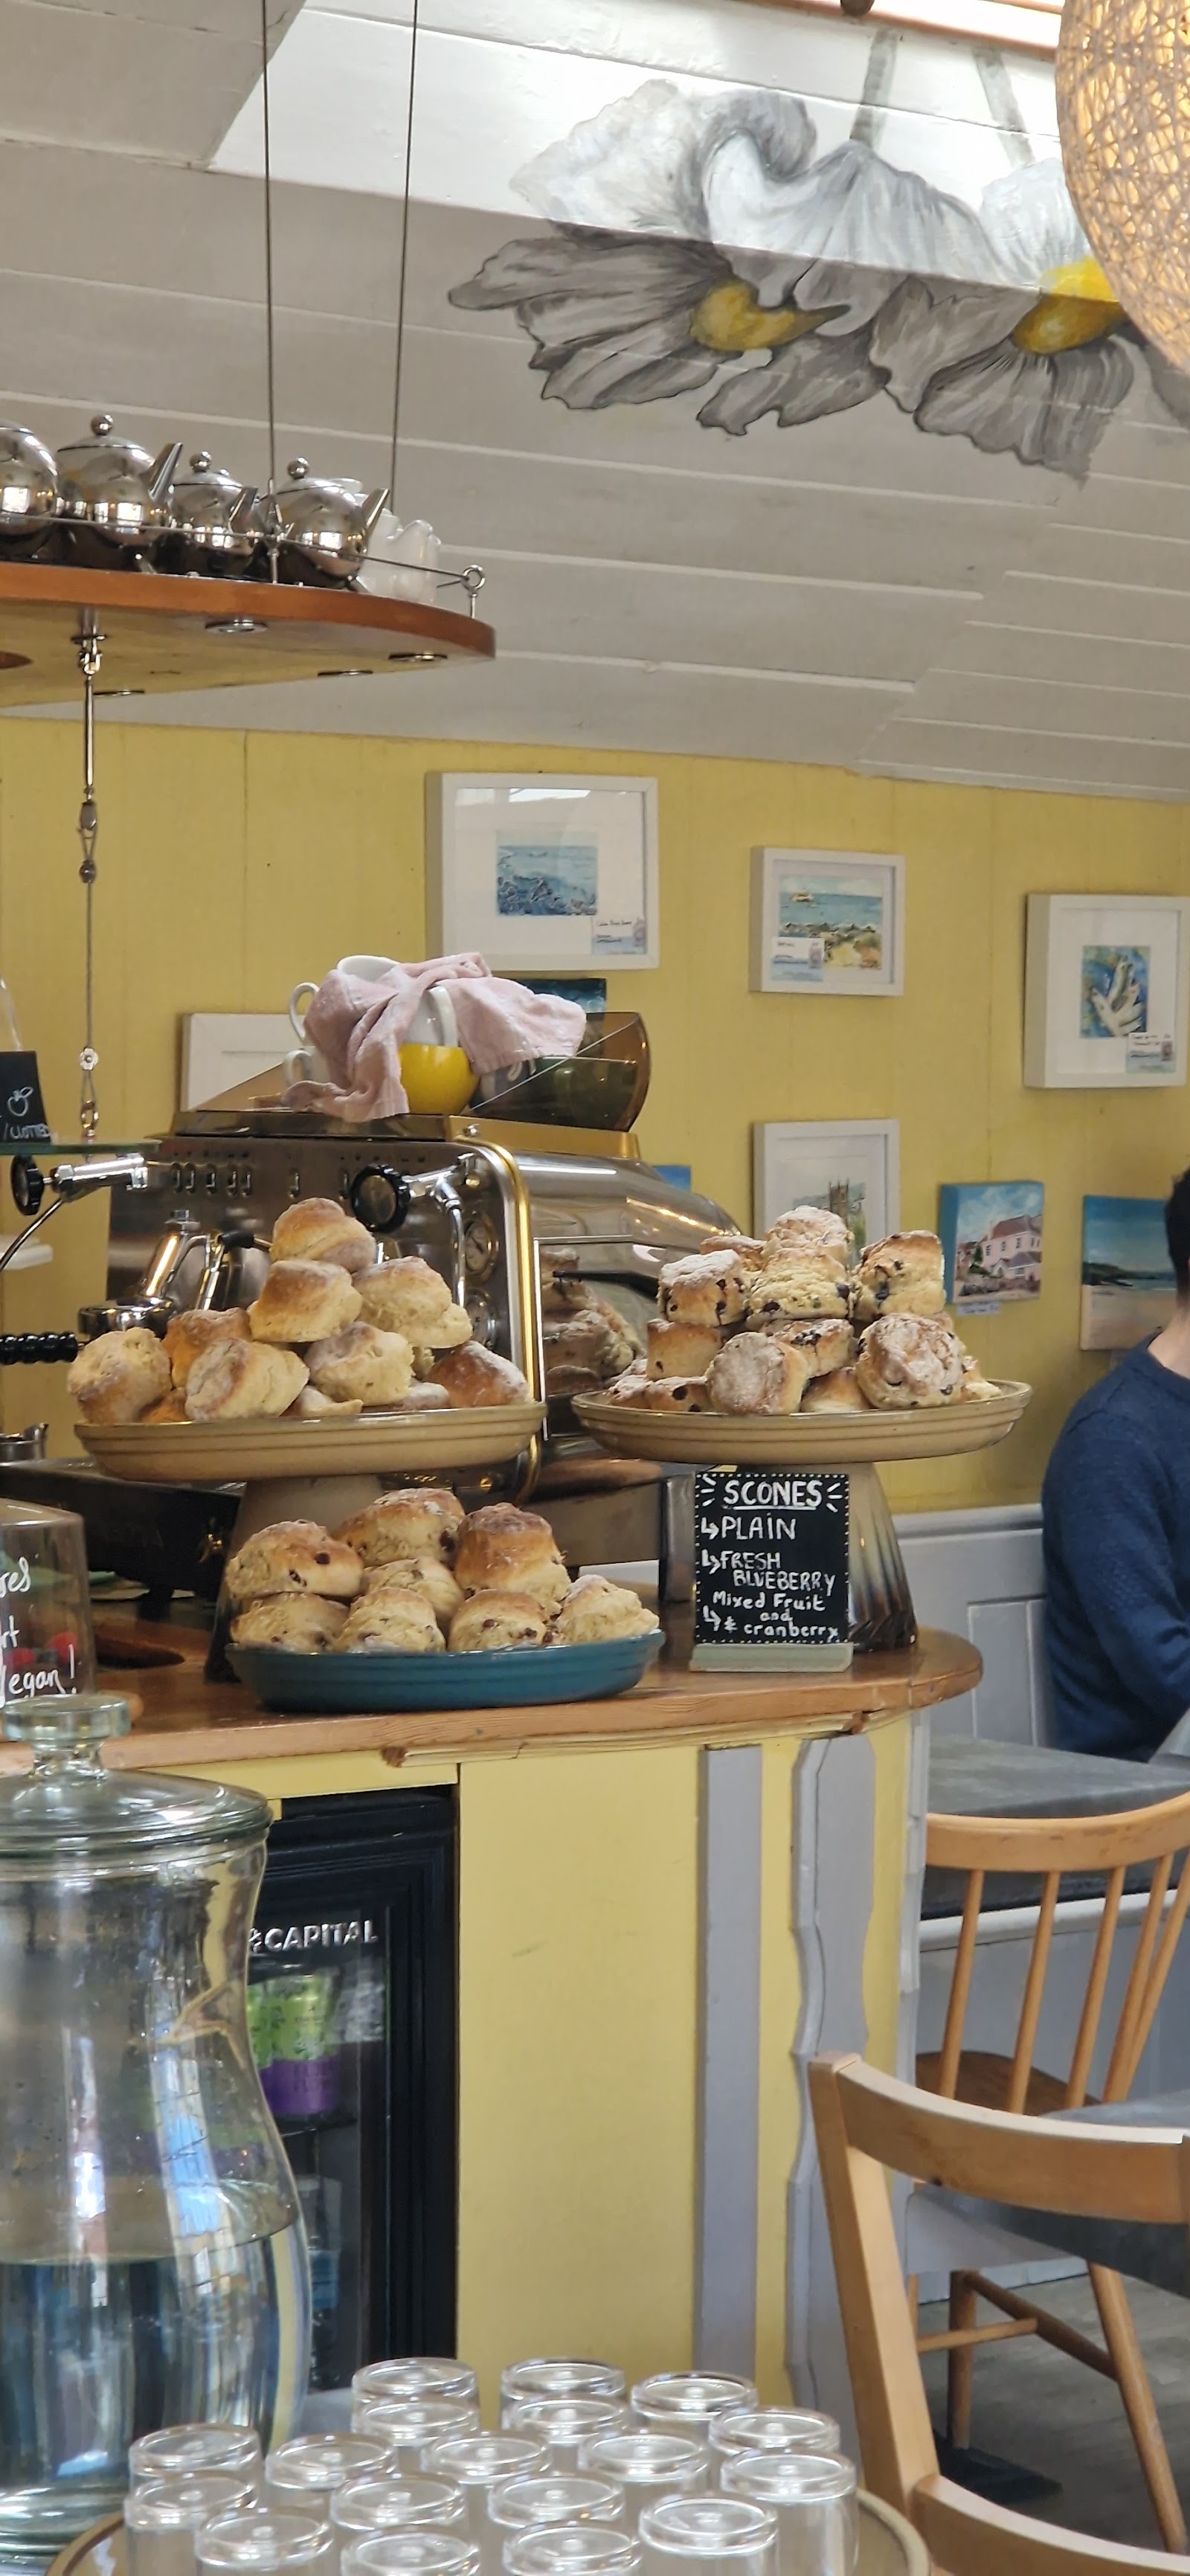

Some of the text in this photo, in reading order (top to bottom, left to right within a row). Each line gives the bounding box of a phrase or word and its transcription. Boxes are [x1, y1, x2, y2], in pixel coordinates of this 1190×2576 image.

[723, 1480, 823, 1506] SCONES
[720, 1550, 781, 1570] FRESH
[733, 1570, 835, 1596] BLUEBERRY
[713, 1590, 826, 1611] Mixed Fruit
[759, 1609, 794, 1622] and
[744, 1621, 839, 1642] cranberry
[265, 1920, 379, 1952] CAPITAL
